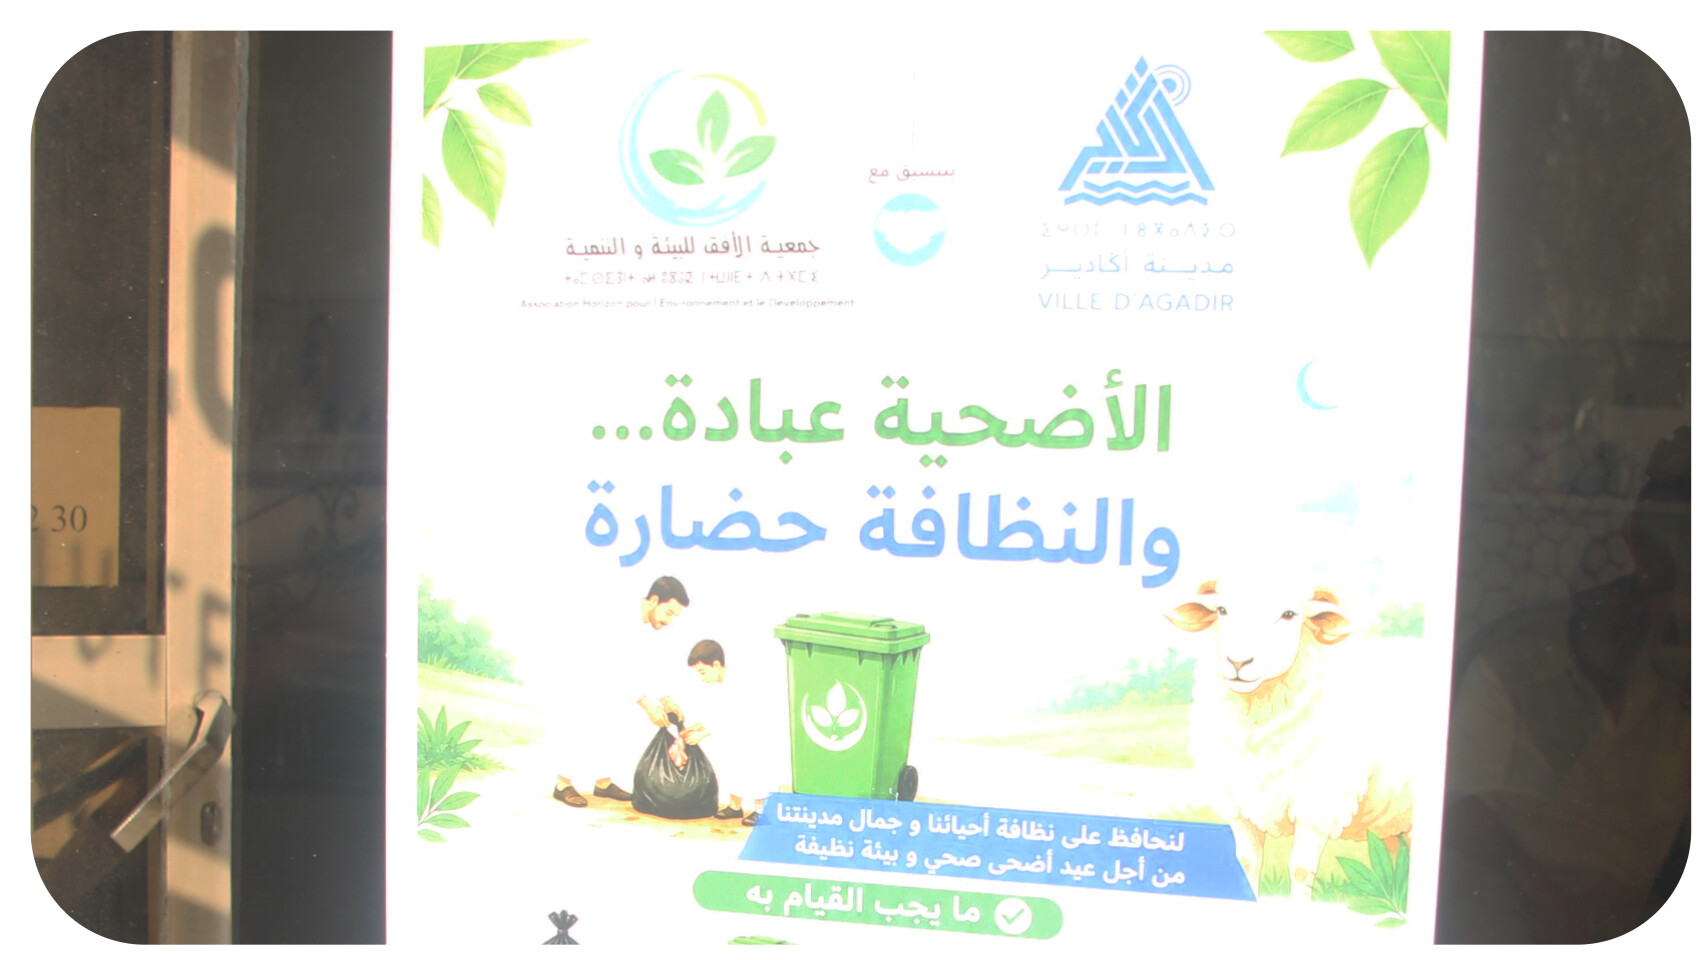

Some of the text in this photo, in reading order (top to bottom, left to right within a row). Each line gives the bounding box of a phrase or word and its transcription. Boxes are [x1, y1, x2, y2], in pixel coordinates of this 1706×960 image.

[868, 167, 889, 184] مع
[565, 230, 821, 261] جمعية الأفق للبيئة و التنمية
[1143, 251, 1234, 281] مدينة
[626, 299, 650, 310] pour
[1037, 292, 1235, 312] VILLE D'AGADIR
[873, 368, 1173, 468] الأضحية
[51, 504, 87, 533] 30
[584, 478, 1181, 589] والنظافة حضارة
[776, 802, 1185, 853] لنحافظ على نظافة أحيائنا و جمال مدينتنا
[794, 833, 1186, 886] من أجل عيد أضحى صحي و بيئة نظيفة
[746, 884, 982, 927] ما يجب القيام به
